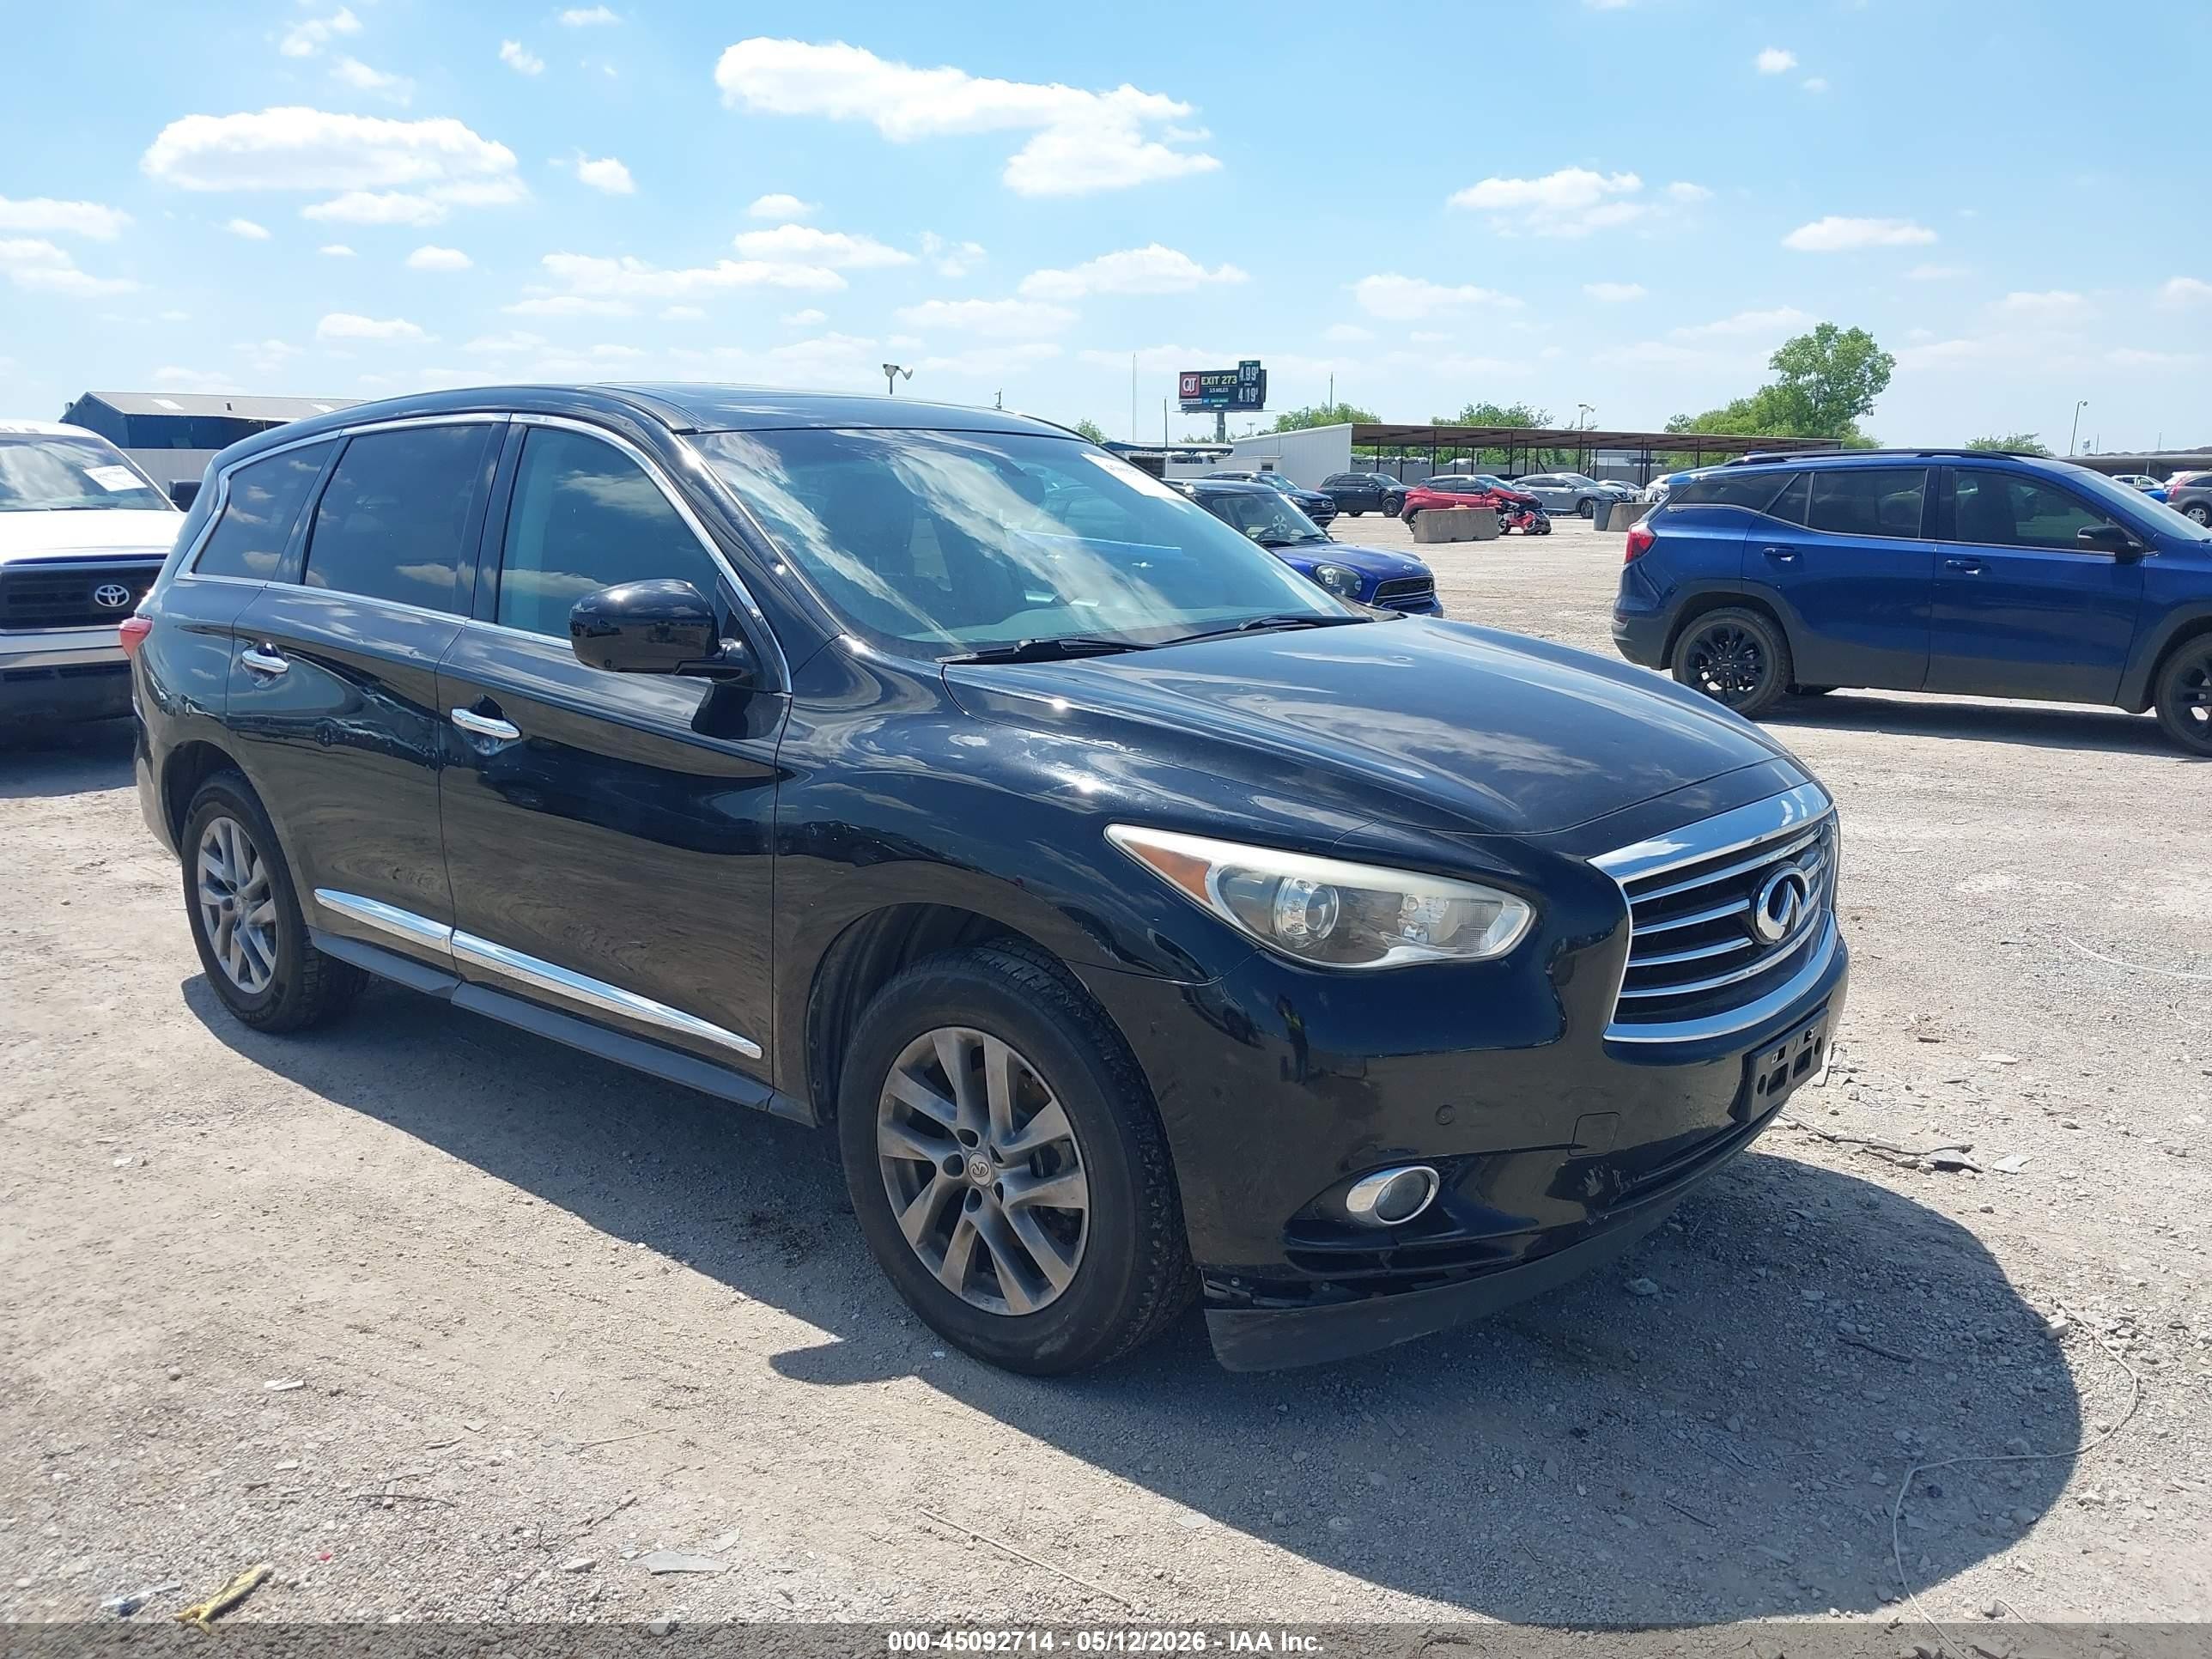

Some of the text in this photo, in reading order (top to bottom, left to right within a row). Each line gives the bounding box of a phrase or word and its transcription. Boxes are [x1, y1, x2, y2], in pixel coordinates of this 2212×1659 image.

[1182, 378, 1196, 392] QT
[1201, 375, 1237, 386] EXIT 273
